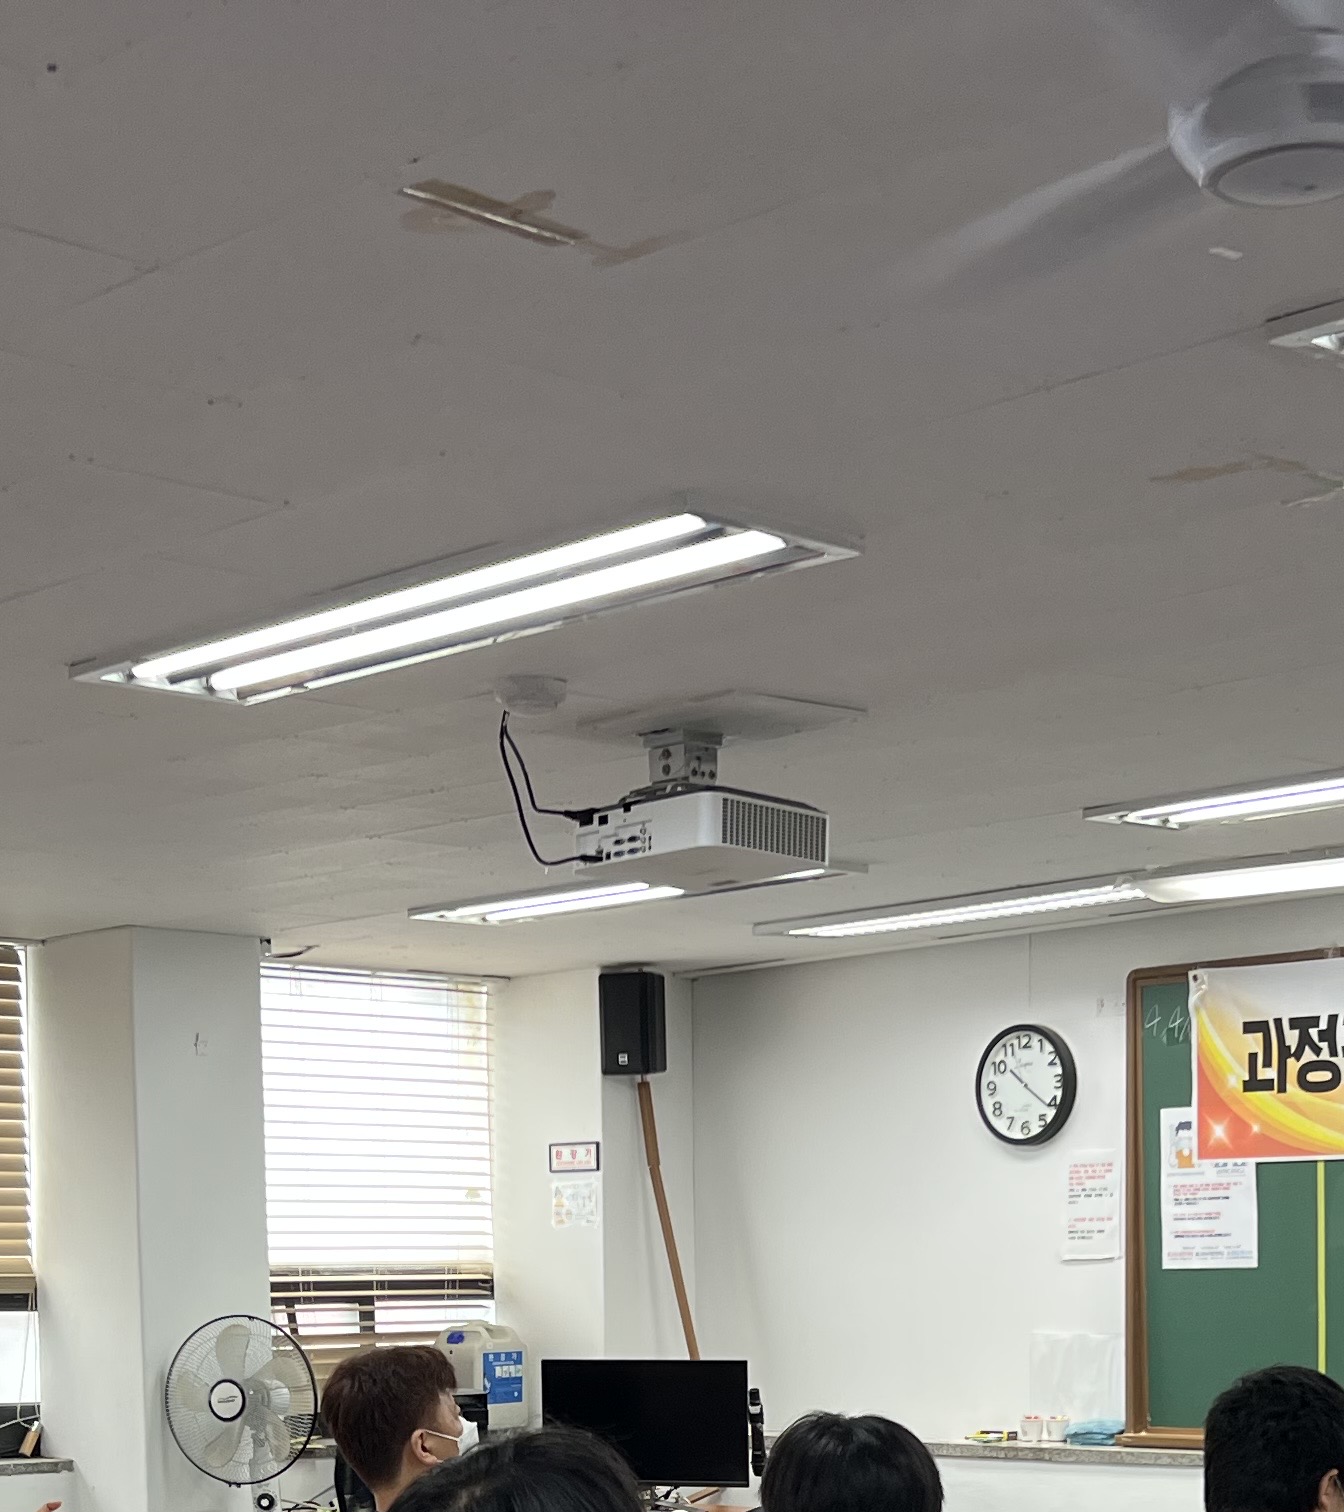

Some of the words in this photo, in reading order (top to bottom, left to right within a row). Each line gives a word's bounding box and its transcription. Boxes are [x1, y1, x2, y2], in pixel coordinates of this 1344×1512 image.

[1016, 1034, 1032, 1049] 12
[1037, 1039, 1044, 1053] 1
[1002, 1043, 1015, 1057] 11
[1047, 1051, 1058, 1066] 2
[991, 1060, 1007, 1075] 10
[986, 1081, 997, 1097] 9
[992, 1101, 1003, 1117] 8
[1006, 1116, 1015, 1131] 7
[1021, 1121, 1031, 1136] 6
[1038, 1114, 1048, 1128] 5
